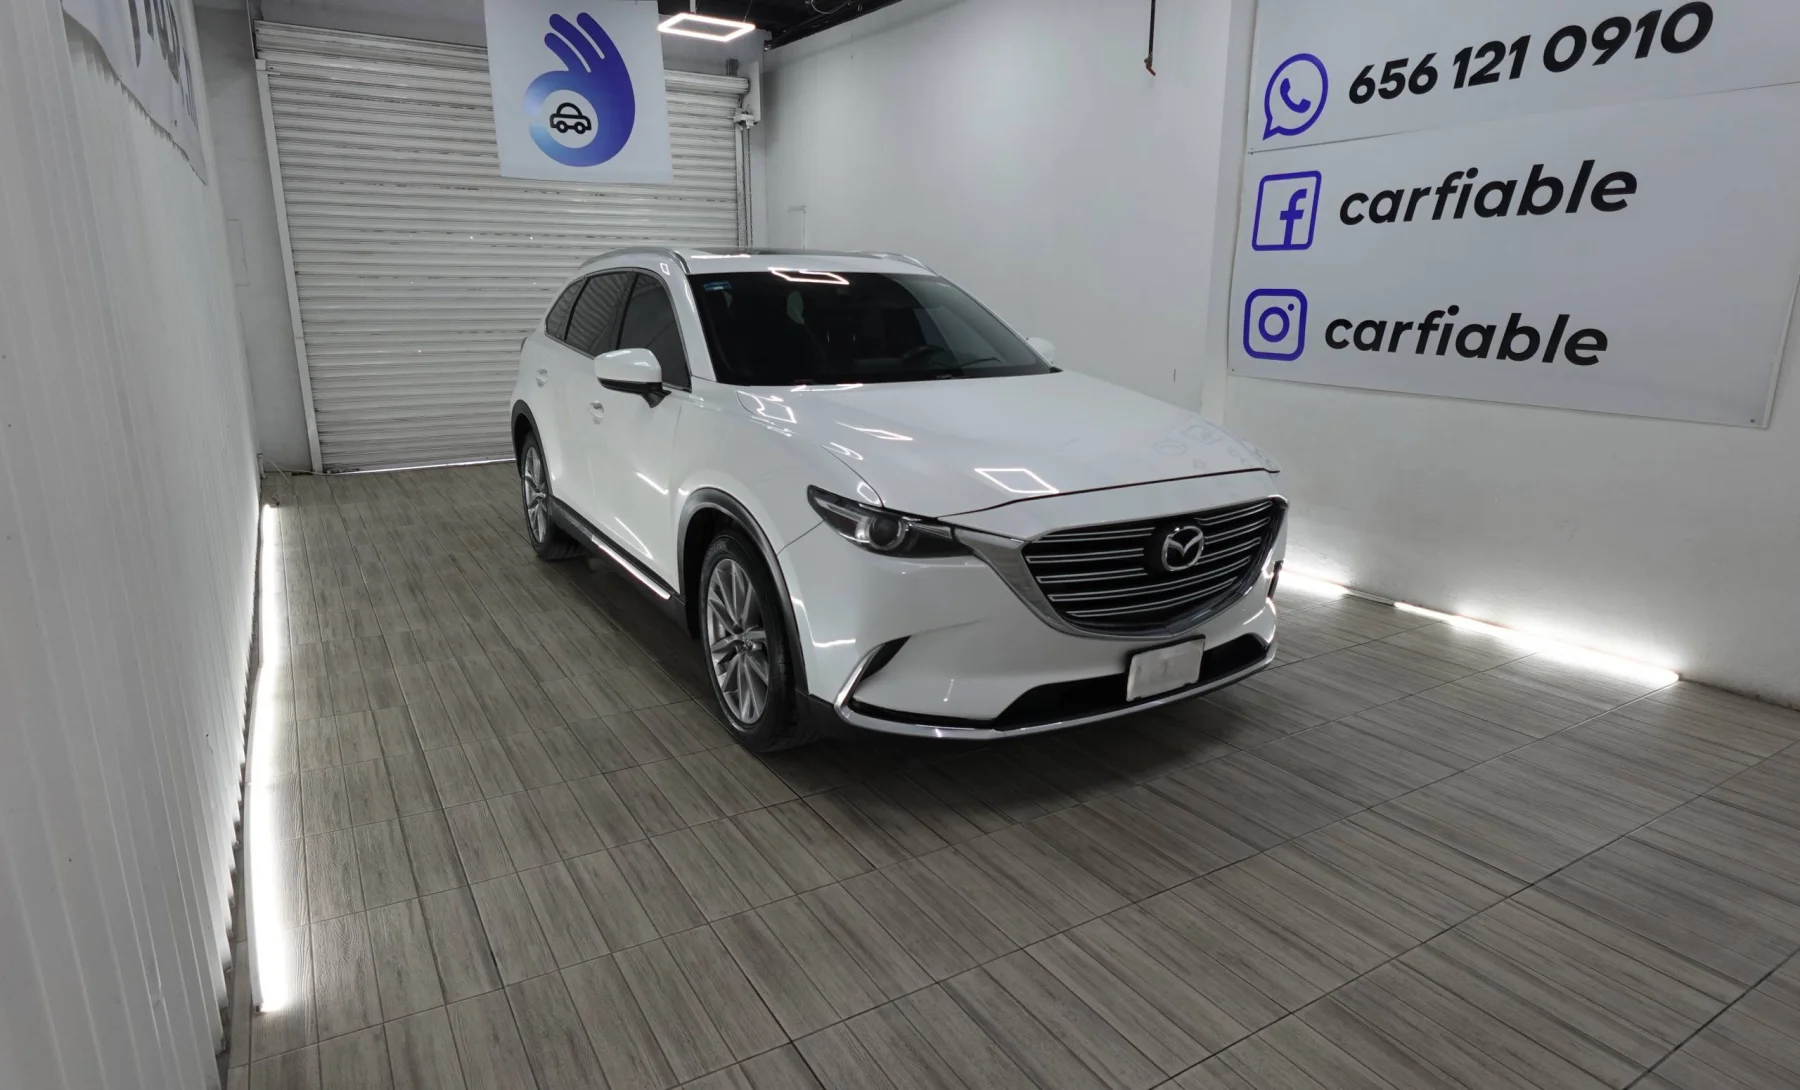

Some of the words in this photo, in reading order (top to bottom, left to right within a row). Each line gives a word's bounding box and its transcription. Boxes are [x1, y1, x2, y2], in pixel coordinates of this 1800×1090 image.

[1348, 52, 1439, 105] 656
[1452, 34, 1532, 90] 121
[1542, 0, 1714, 74] 0910
[1338, 159, 1638, 226] carfiable
[1324, 304, 1609, 366] carfiable
